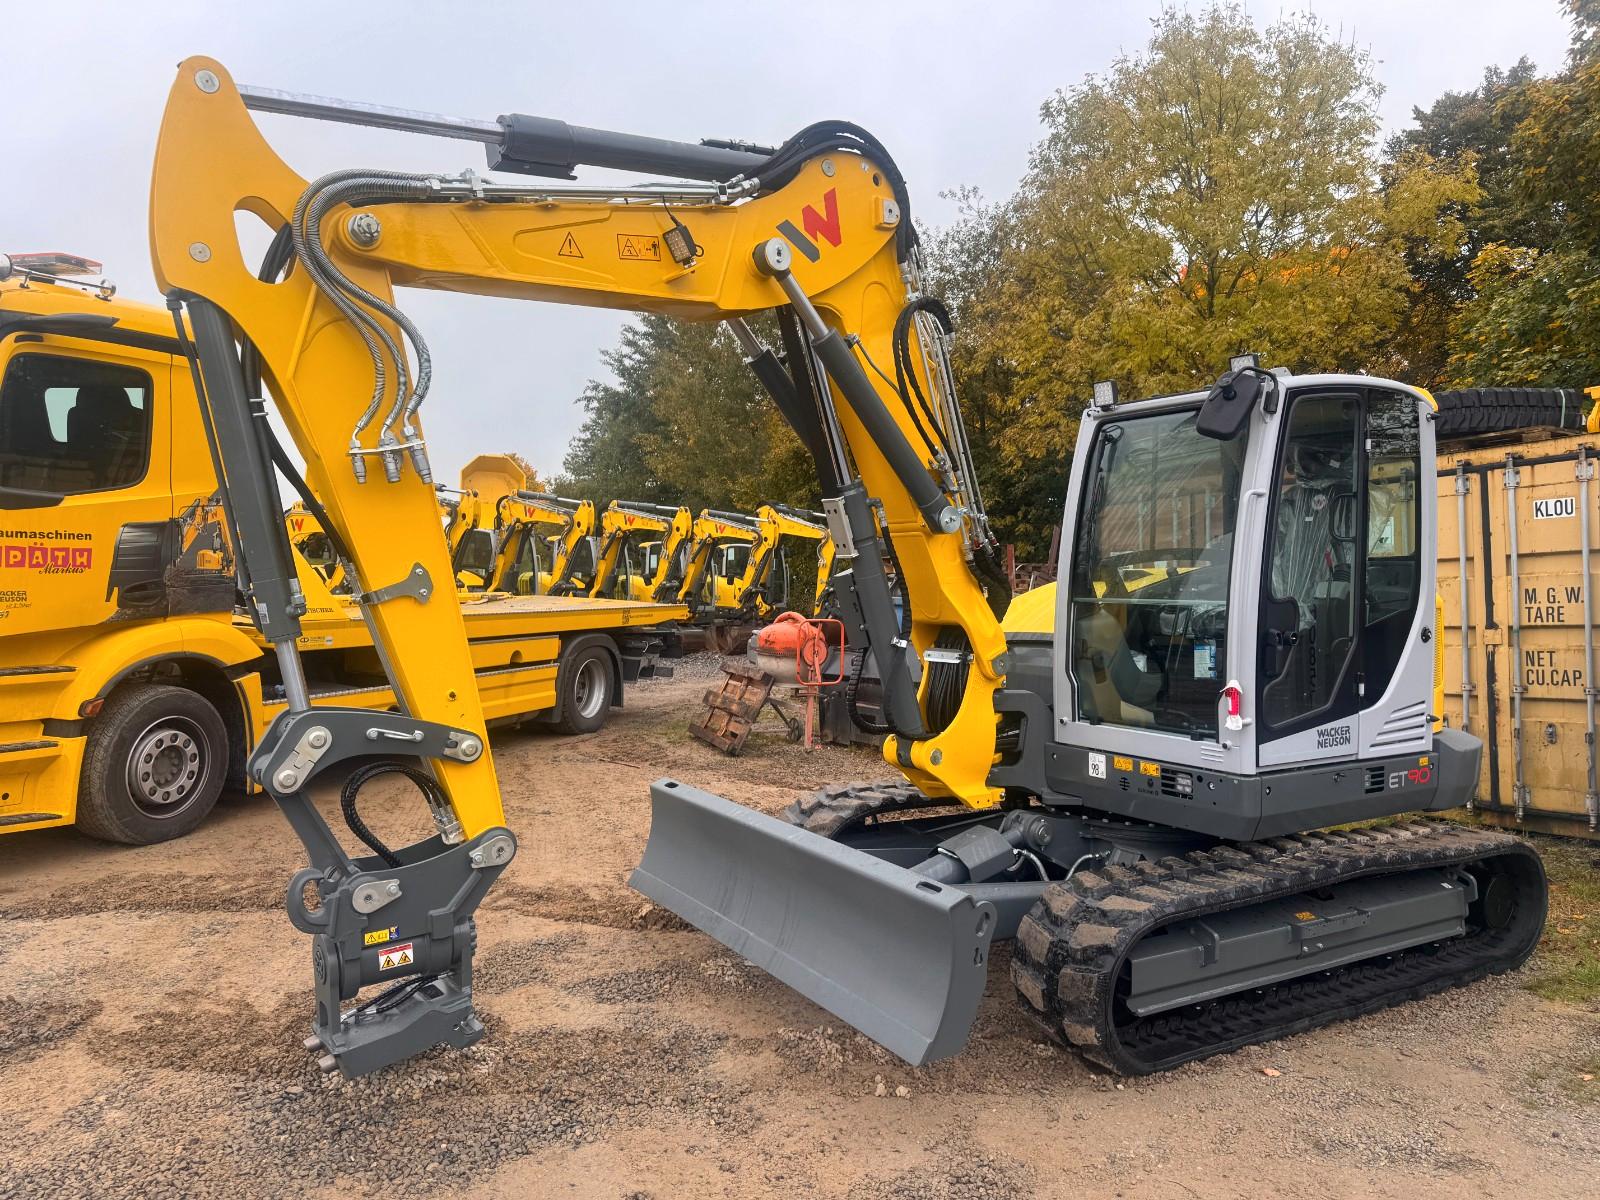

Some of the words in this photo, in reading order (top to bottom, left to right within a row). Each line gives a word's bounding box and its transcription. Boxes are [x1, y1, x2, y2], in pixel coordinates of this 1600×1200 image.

[1535, 499, 1575, 518] KLOU
[38, 562, 85, 574] Markus
[1525, 588, 1542, 604] M.
[1547, 588, 1560, 604] G.
[1565, 587, 1585, 604] W.
[1525, 606, 1565, 623] TARE
[1525, 651, 1556, 667] NET
[1526, 670, 1585, 687] CU.CAP.
[1317, 725, 1350, 738] WACKER
[1317, 735, 1350, 749] NEUSON
[1091, 763, 1100, 776] 98
[1389, 767, 1432, 788] ET90
